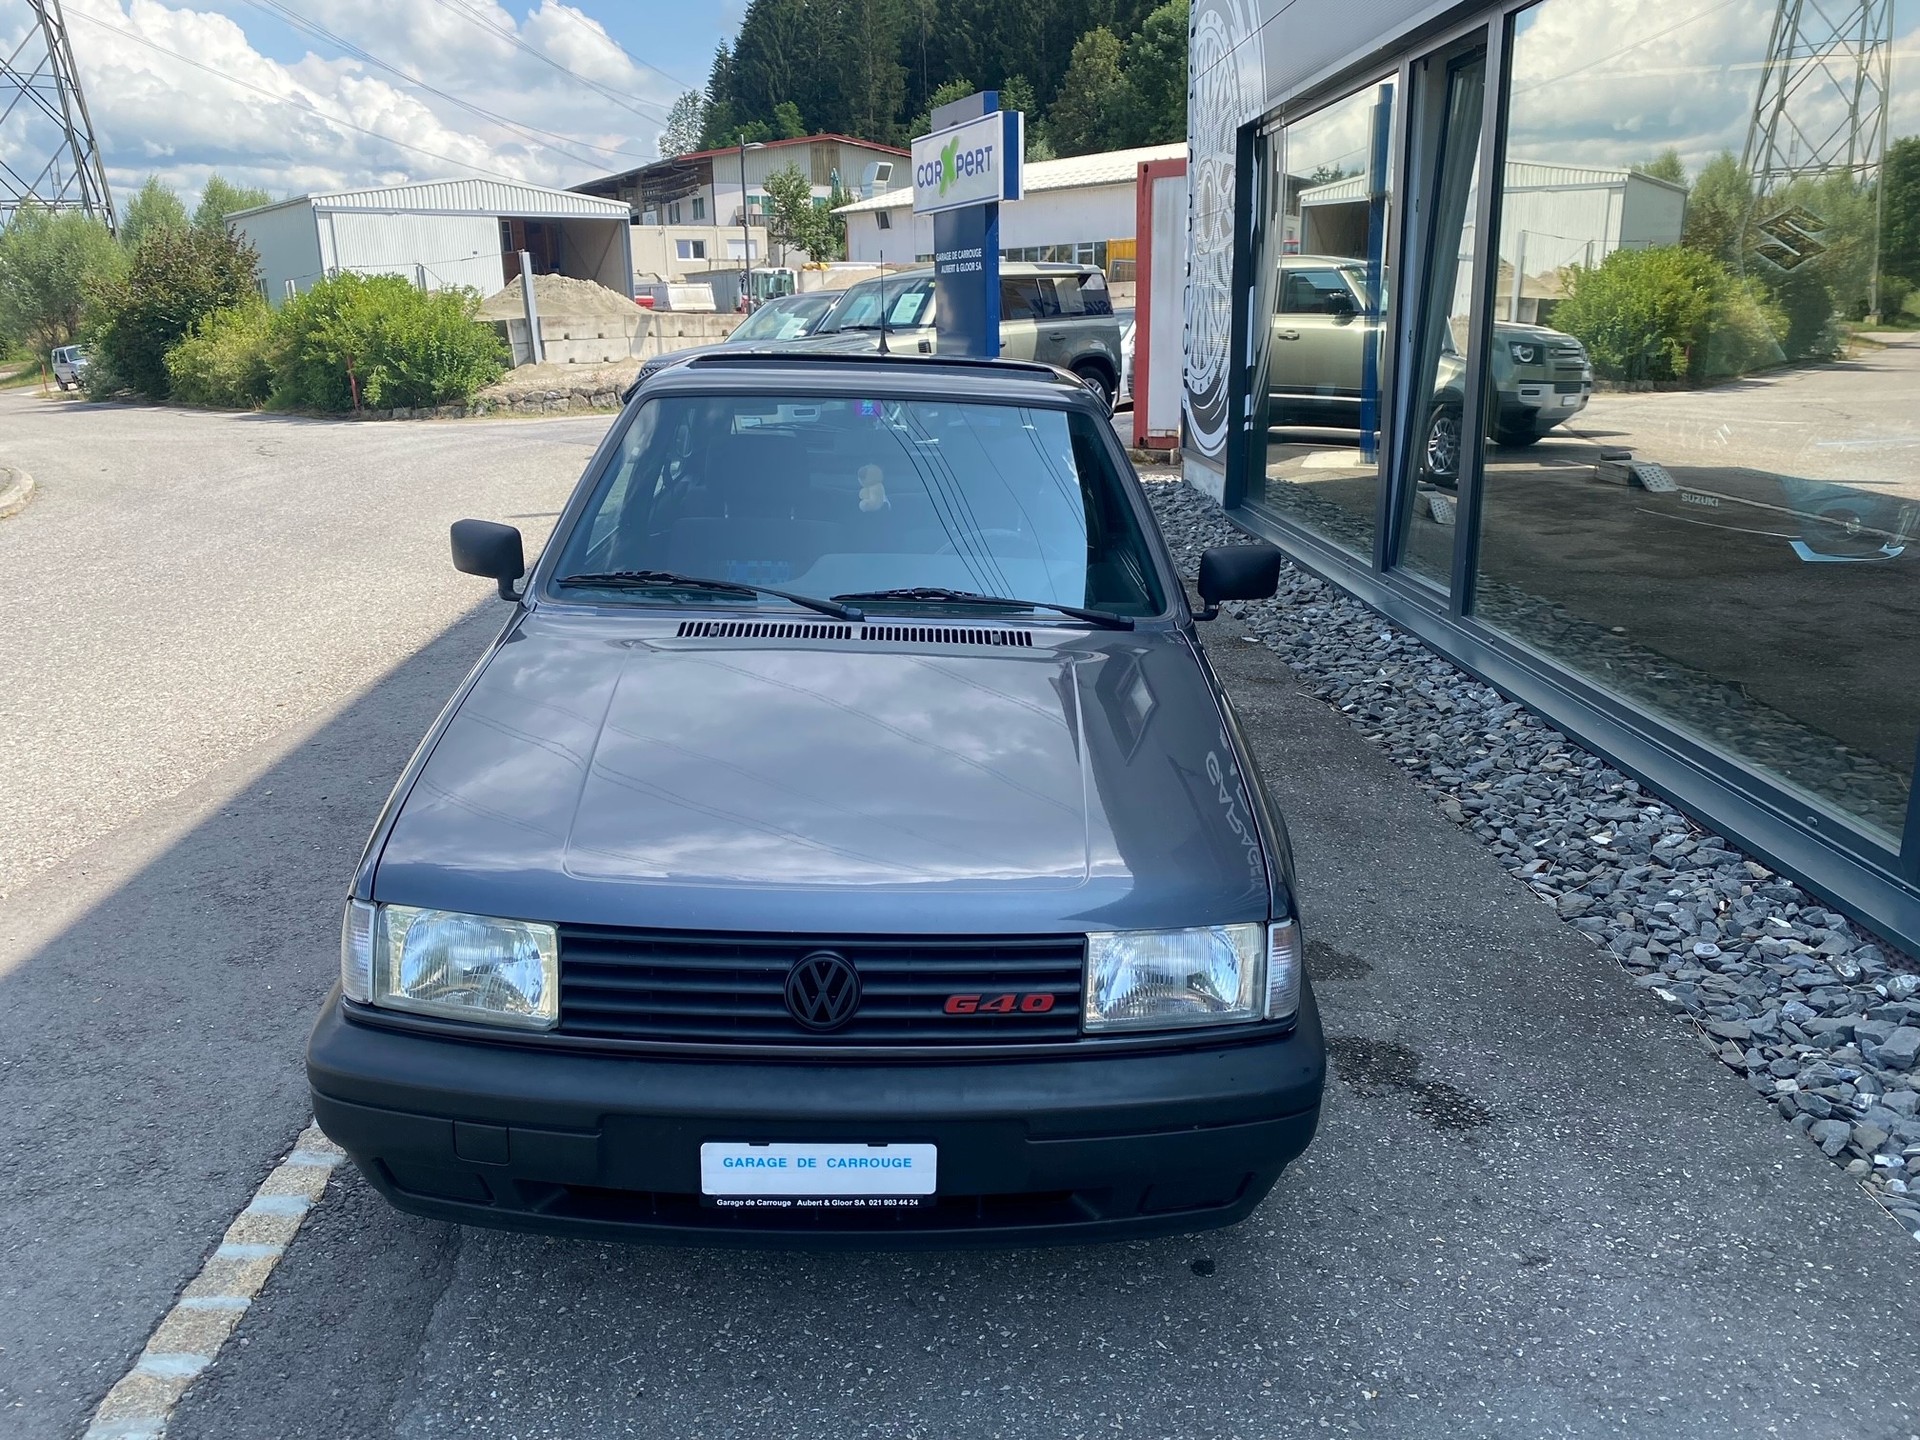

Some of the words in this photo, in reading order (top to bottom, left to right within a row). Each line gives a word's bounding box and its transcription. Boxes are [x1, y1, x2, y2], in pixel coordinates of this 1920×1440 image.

[936, 251, 951, 262] GARAGE
[952, 250, 958, 260] DE
[958, 248, 982, 259] CARROUGE
[960, 262, 975, 272] GLOOR
[976, 261, 983, 271] SA
[1681, 492, 1719, 507] SUZUKI
[944, 993, 1055, 1014] G40
[723, 1157, 788, 1168] GARAGE
[797, 1157, 817, 1168] DE
[826, 1157, 912, 1168] CARROUGE
[716, 1199, 744, 1207] Garage
[756, 1199, 791, 1207] Carrouge
